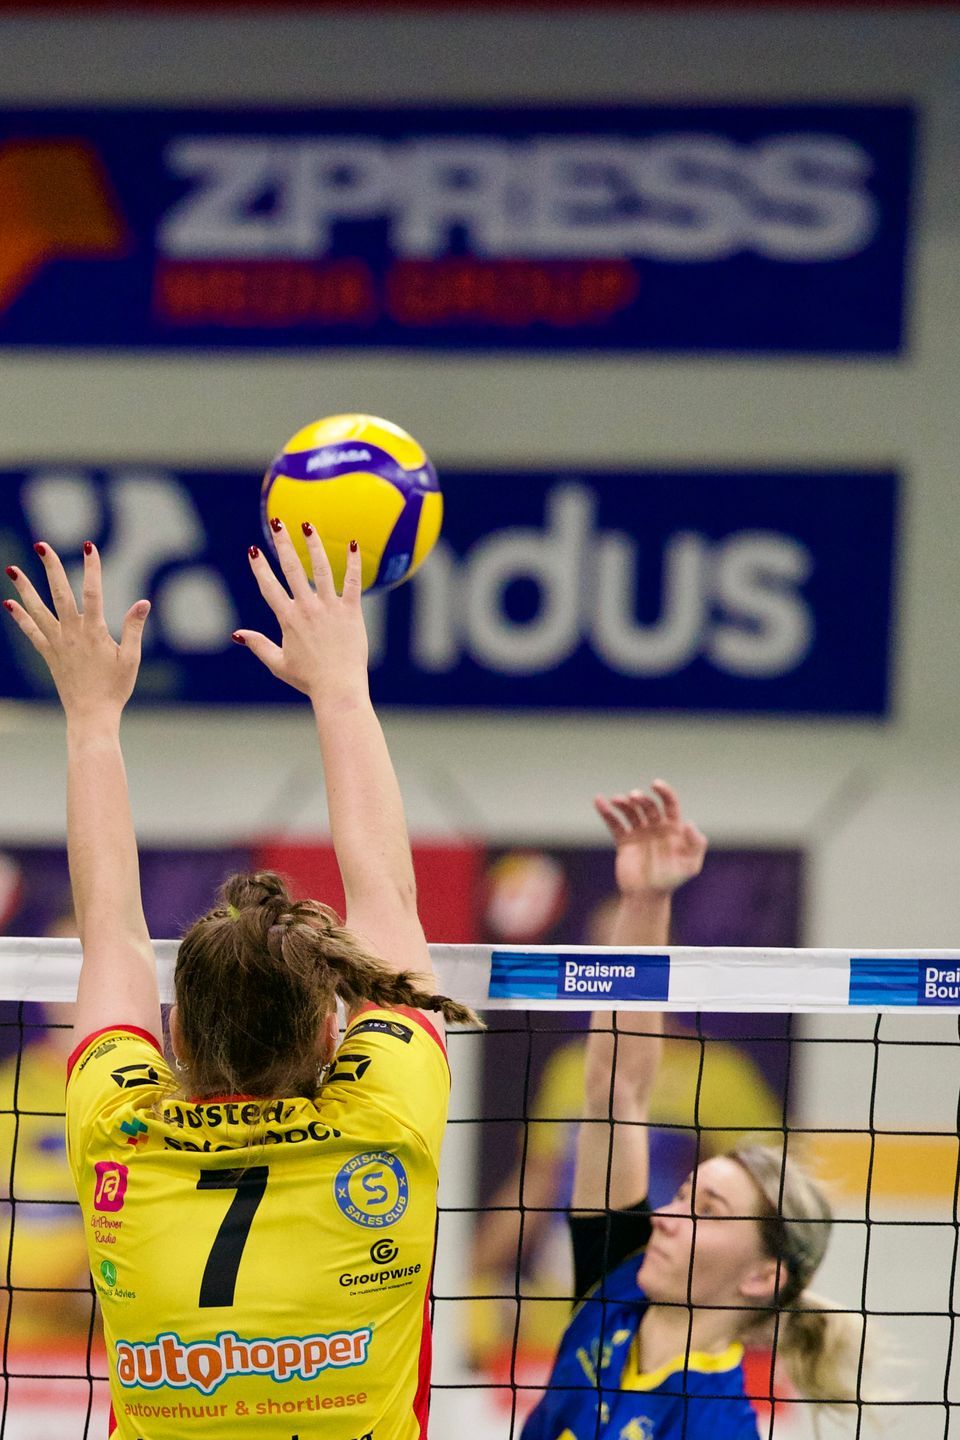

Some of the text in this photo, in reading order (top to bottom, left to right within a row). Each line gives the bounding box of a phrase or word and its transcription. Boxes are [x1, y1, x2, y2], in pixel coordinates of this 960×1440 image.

[157, 134, 876, 262] ZPRESS
[564, 961, 636, 979] Draisma
[564, 977, 613, 994] Bouw
[925, 983, 960, 999] Bou
[163, 1100, 296, 1129] Hofsted
[343, 1152, 395, 1174] KPI SALES
[345, 1195, 407, 1226] SALES CLUB
[94, 1231, 117, 1244] Radio
[196, 1165, 269, 1308] 7
[339, 1263, 421, 1288] Groupwise
[117, 1330, 369, 1392] autohopper
[124, 1391, 368, 1419] autoverhuur & shortlease
